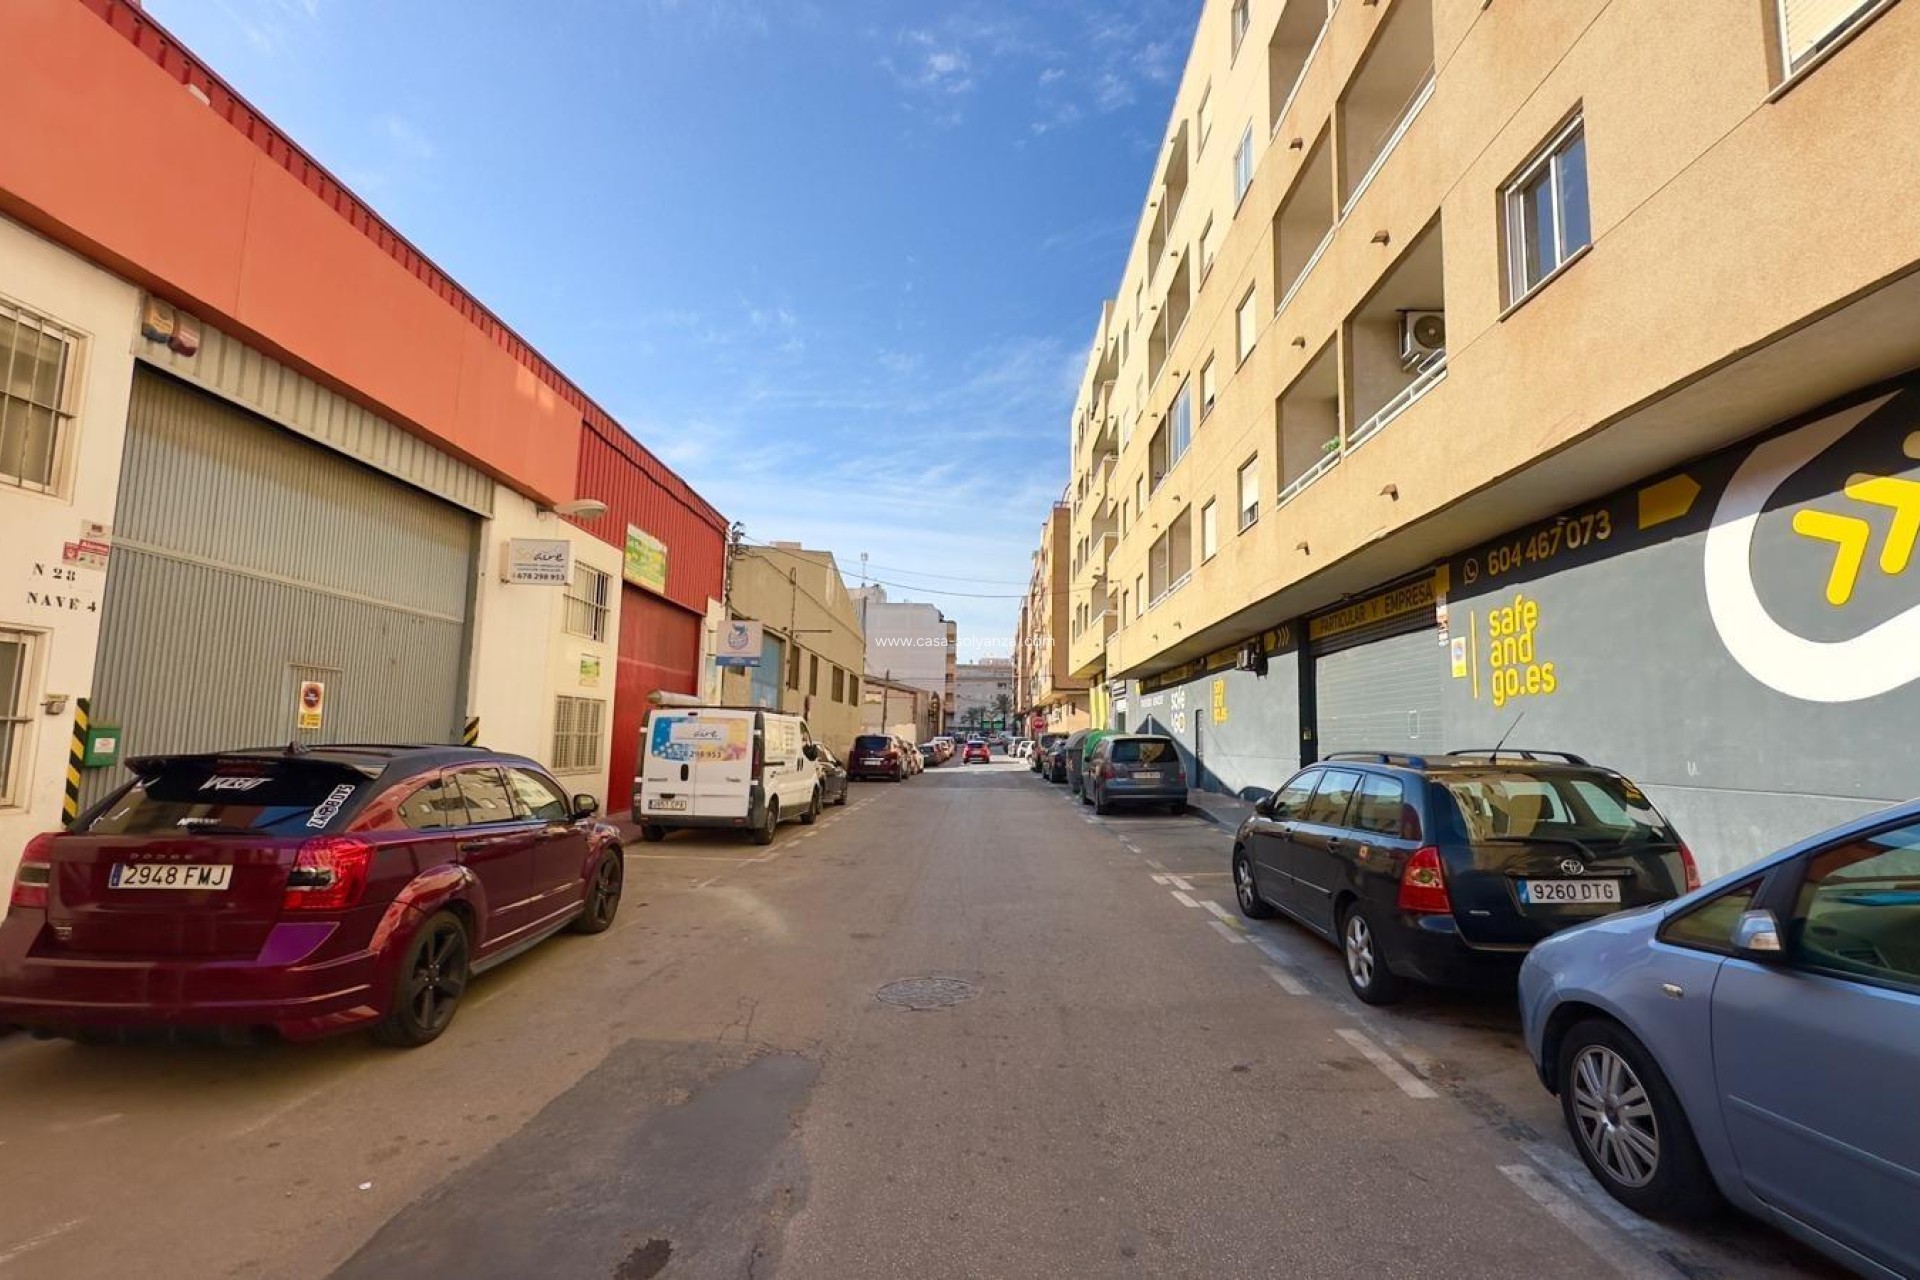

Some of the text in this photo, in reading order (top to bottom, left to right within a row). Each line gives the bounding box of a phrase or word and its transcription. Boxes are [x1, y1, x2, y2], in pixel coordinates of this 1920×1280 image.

[1488, 510, 1611, 576] 604 467 073
[52, 568, 75, 581] 28
[27, 591, 96, 612] NAVE 4
[1320, 606, 1365, 635] PARTICULAR
[1384, 582, 1434, 613] EMPRESA
[1489, 594, 1538, 637] safe
[1490, 629, 1533, 667] and
[1492, 662, 1557, 706] go.es
[124, 865, 226, 885] 2948 FMJ
[1533, 884, 1613, 900] 9260 DTG
